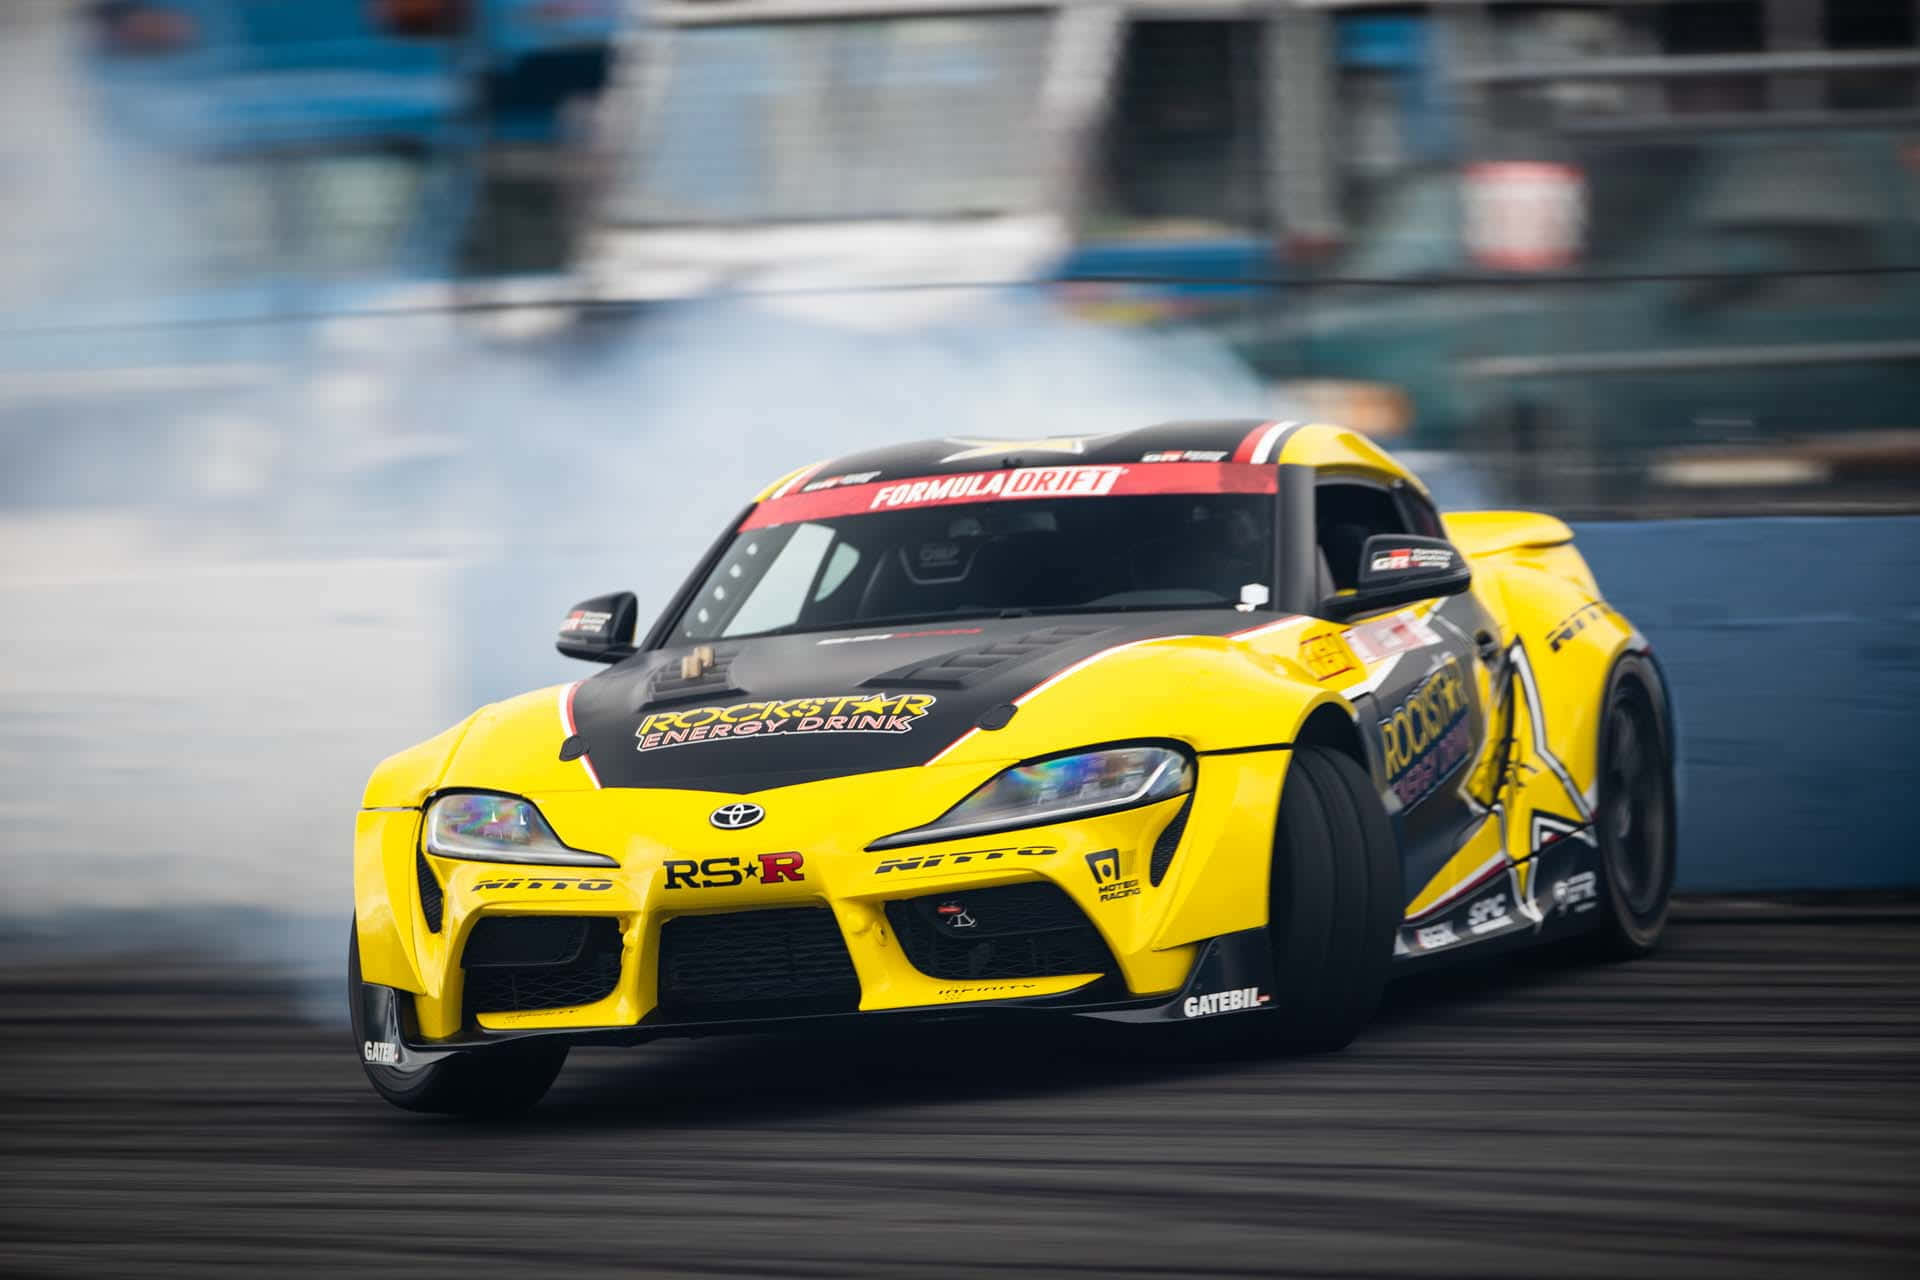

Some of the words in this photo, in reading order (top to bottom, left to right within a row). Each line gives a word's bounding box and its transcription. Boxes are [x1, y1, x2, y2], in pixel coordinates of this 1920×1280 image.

[869, 473, 1004, 510] FORMULA
[1004, 467, 1118, 496] DRIFT
[638, 693, 933, 735] ROCKSTAR
[641, 718, 789, 749] ENERGY
[796, 714, 913, 731] DRINK
[875, 845, 1059, 875] NITTO
[470, 877, 614, 892] NITTO
[1098, 879, 1139, 894] MOTEGI
[1100, 888, 1141, 903] RACING
